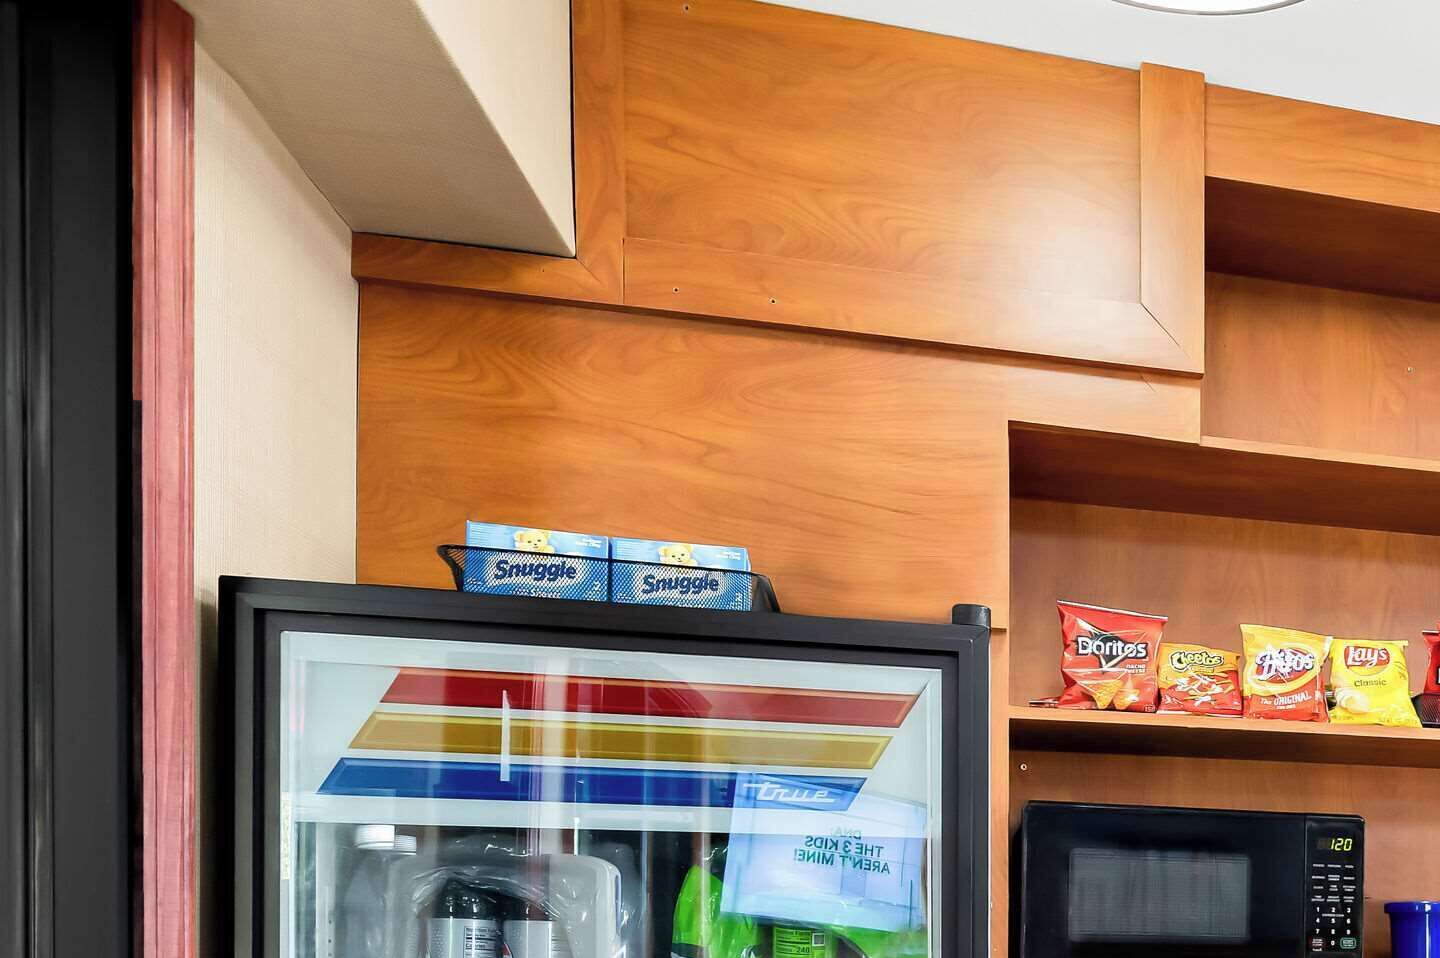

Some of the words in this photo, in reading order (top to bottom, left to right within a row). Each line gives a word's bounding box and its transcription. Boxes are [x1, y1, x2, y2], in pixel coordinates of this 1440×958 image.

[494, 559, 577, 581] Snuggle
[642, 574, 720, 595] Snuggle
[1077, 636, 1148, 658] Doritos
[1347, 646, 1389, 667] Lay's
[1169, 650, 1224, 672] Cheetos
[743, 781, 835, 803] true
